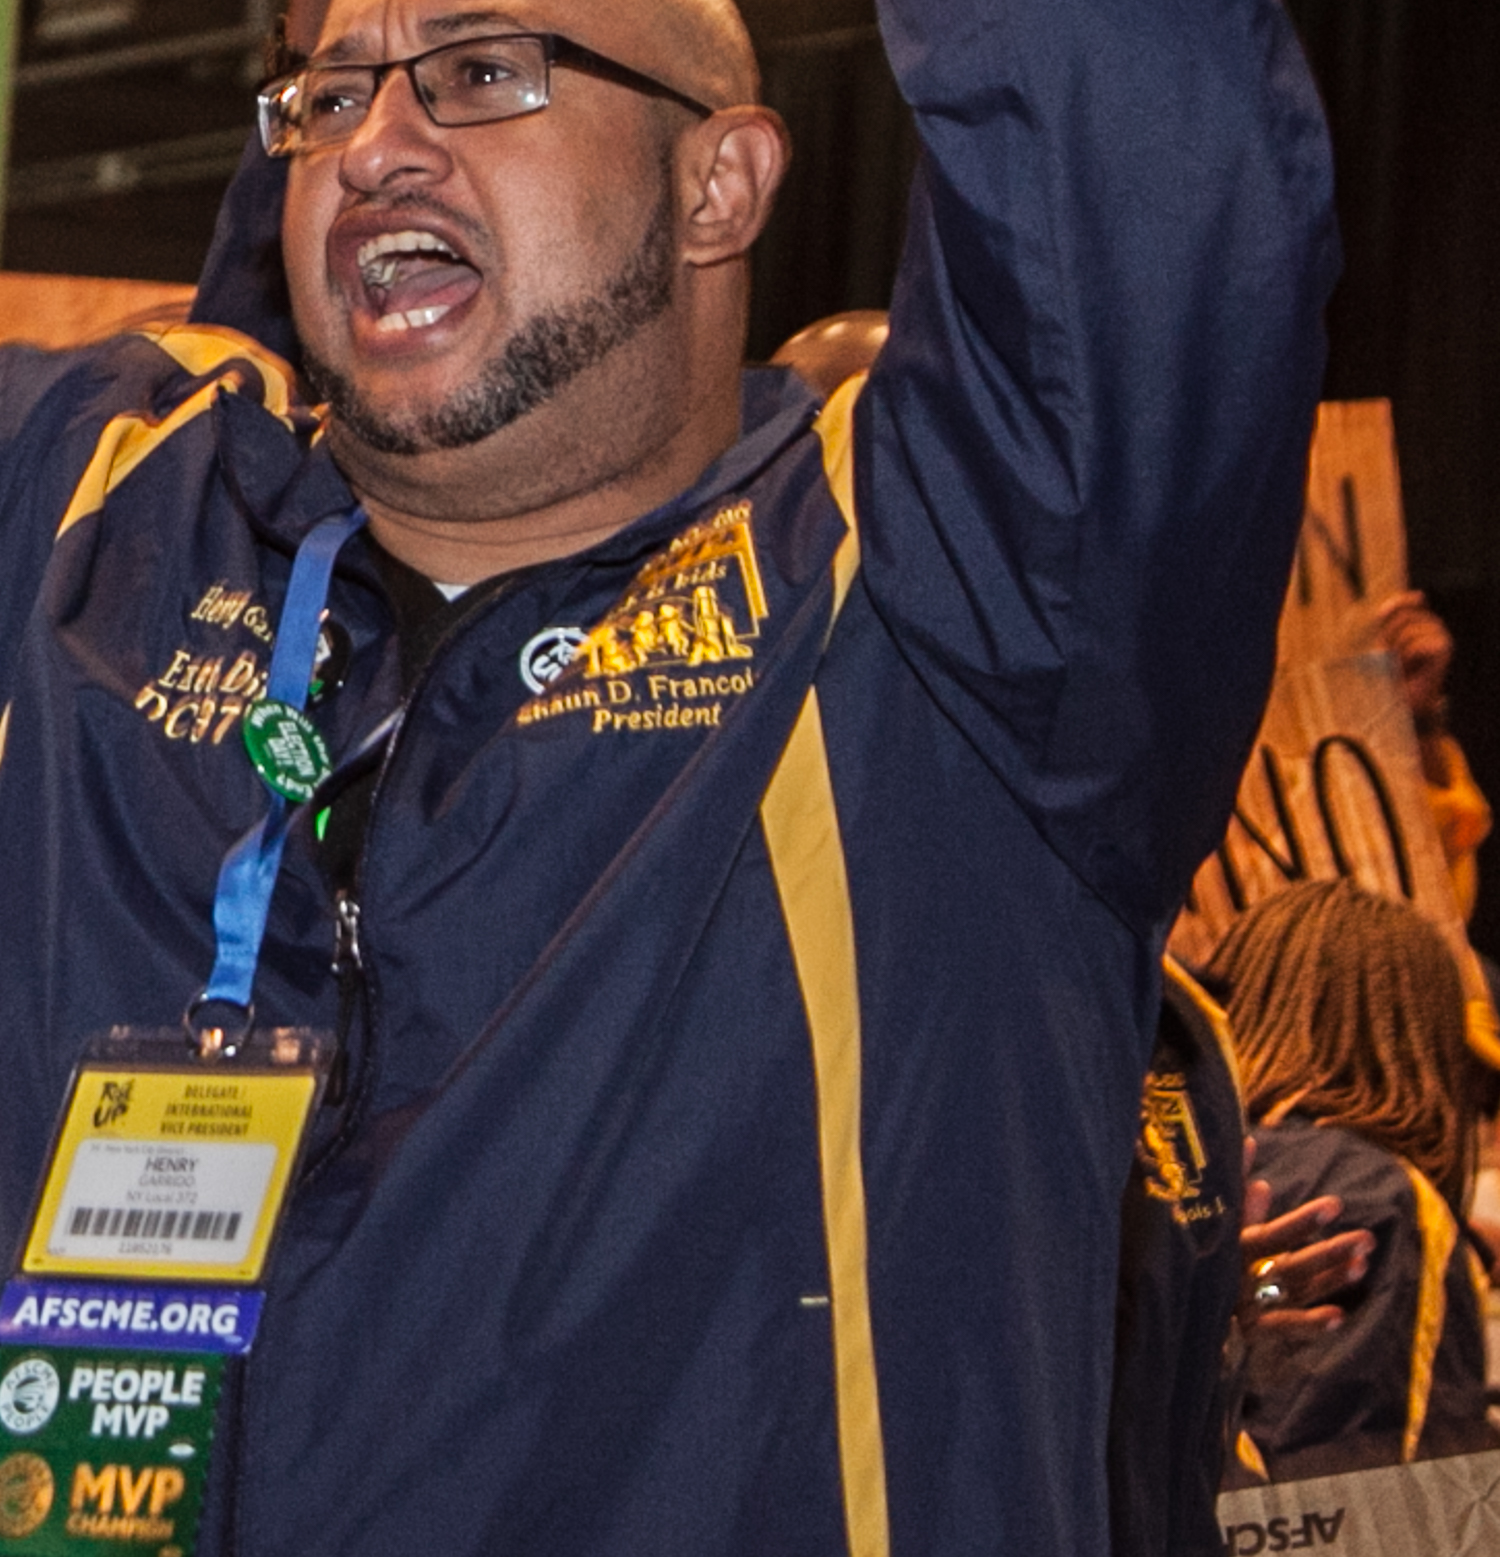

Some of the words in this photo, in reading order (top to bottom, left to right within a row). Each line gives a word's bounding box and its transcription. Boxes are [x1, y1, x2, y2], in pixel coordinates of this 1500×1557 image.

[648, 666, 755, 701] Francoi
[592, 702, 723, 734] President
[165, 1104, 253, 1119] INTERNATIONAL
[187, 1122, 249, 1136] PRESIDENT
[145, 1157, 198, 1172] HENRY
[12, 1296, 239, 1335] AFSCME.ORG
[68, 1367, 205, 1405] PEOPLE
[91, 1403, 170, 1438] MVP
[69, 1461, 185, 1516] MVP
